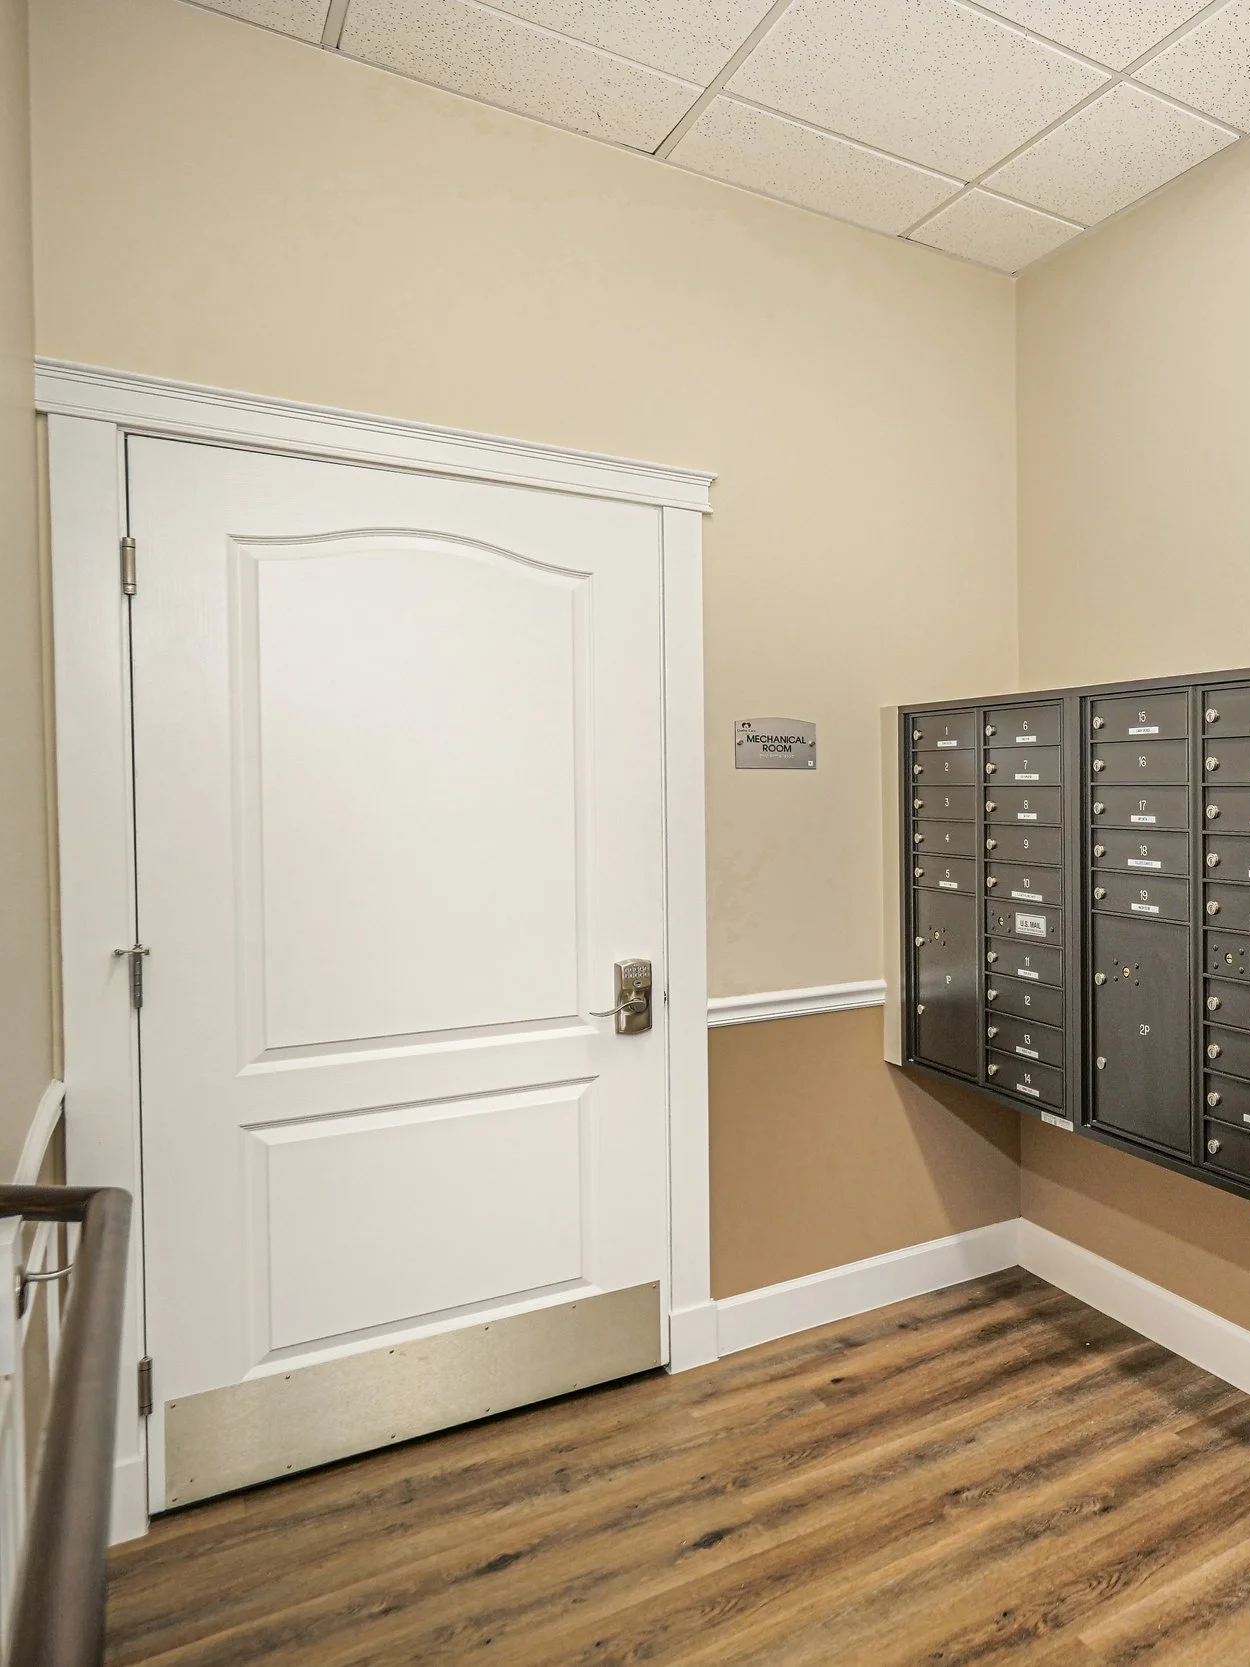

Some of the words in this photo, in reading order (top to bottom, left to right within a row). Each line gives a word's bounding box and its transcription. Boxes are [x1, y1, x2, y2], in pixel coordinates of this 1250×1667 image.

[1138, 711, 1147, 723] 15
[1022, 720, 1028, 731] 6
[746, 735, 806, 744] MECHANICAL
[762, 744, 792, 752] ROOM
[1023, 759, 1028, 770] 7
[1138, 755, 1147, 767] 16
[1023, 799, 1029, 810] 8
[1138, 799, 1147, 811] 17
[1023, 838, 1029, 849] 9
[1139, 844, 1148, 857] 18
[1023, 878, 1030, 889] 10
[1139, 889, 1148, 901] 19
[1024, 956, 1030, 967] 11
[1024, 995, 1031, 1006] 12
[1139, 1023, 1151, 1036] 2P
[1023, 1034, 1031, 1045] 13
[1024, 1073, 1032, 1084] 14
